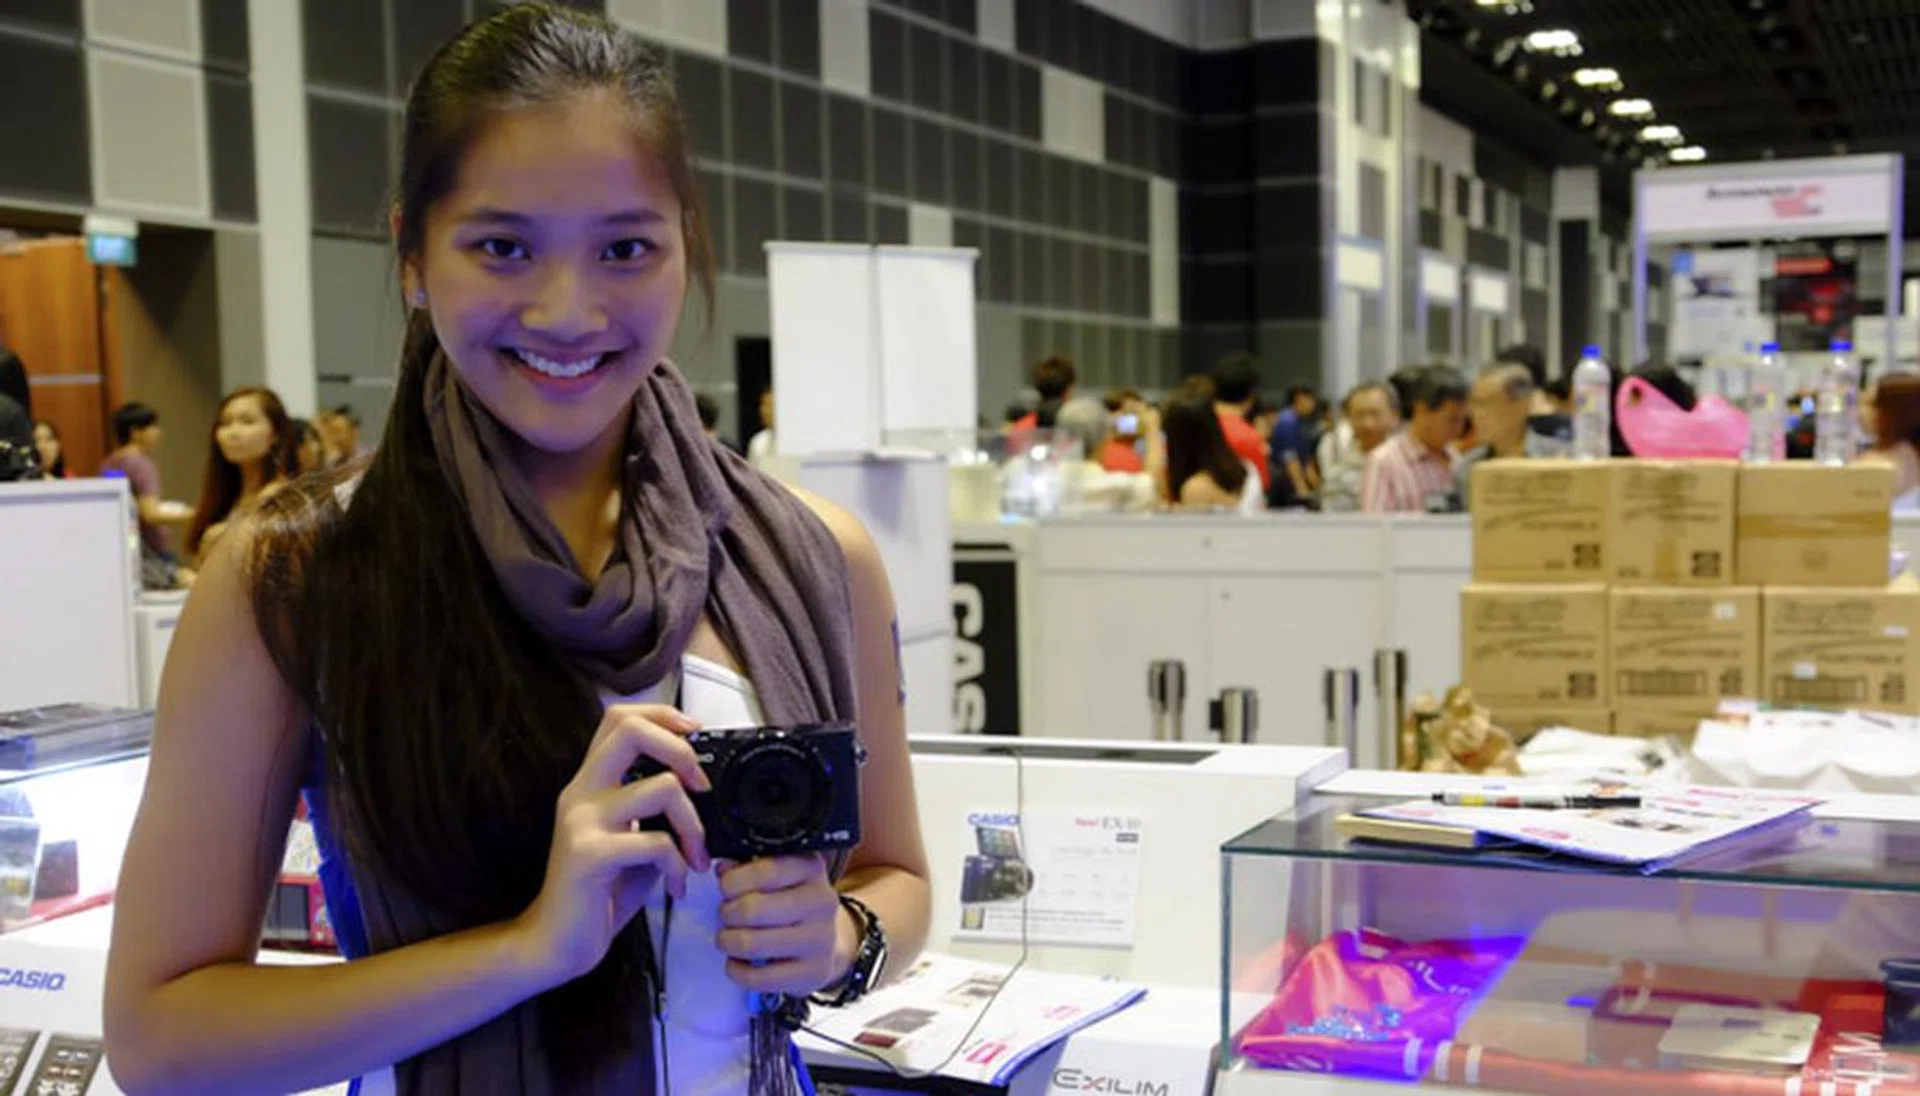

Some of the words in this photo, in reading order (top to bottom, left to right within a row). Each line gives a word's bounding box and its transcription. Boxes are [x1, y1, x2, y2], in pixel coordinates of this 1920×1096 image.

[967, 813, 1021, 826] CASIO
[0, 967, 66, 991] CASIO
[1052, 1067, 1170, 1096] EXILIM
